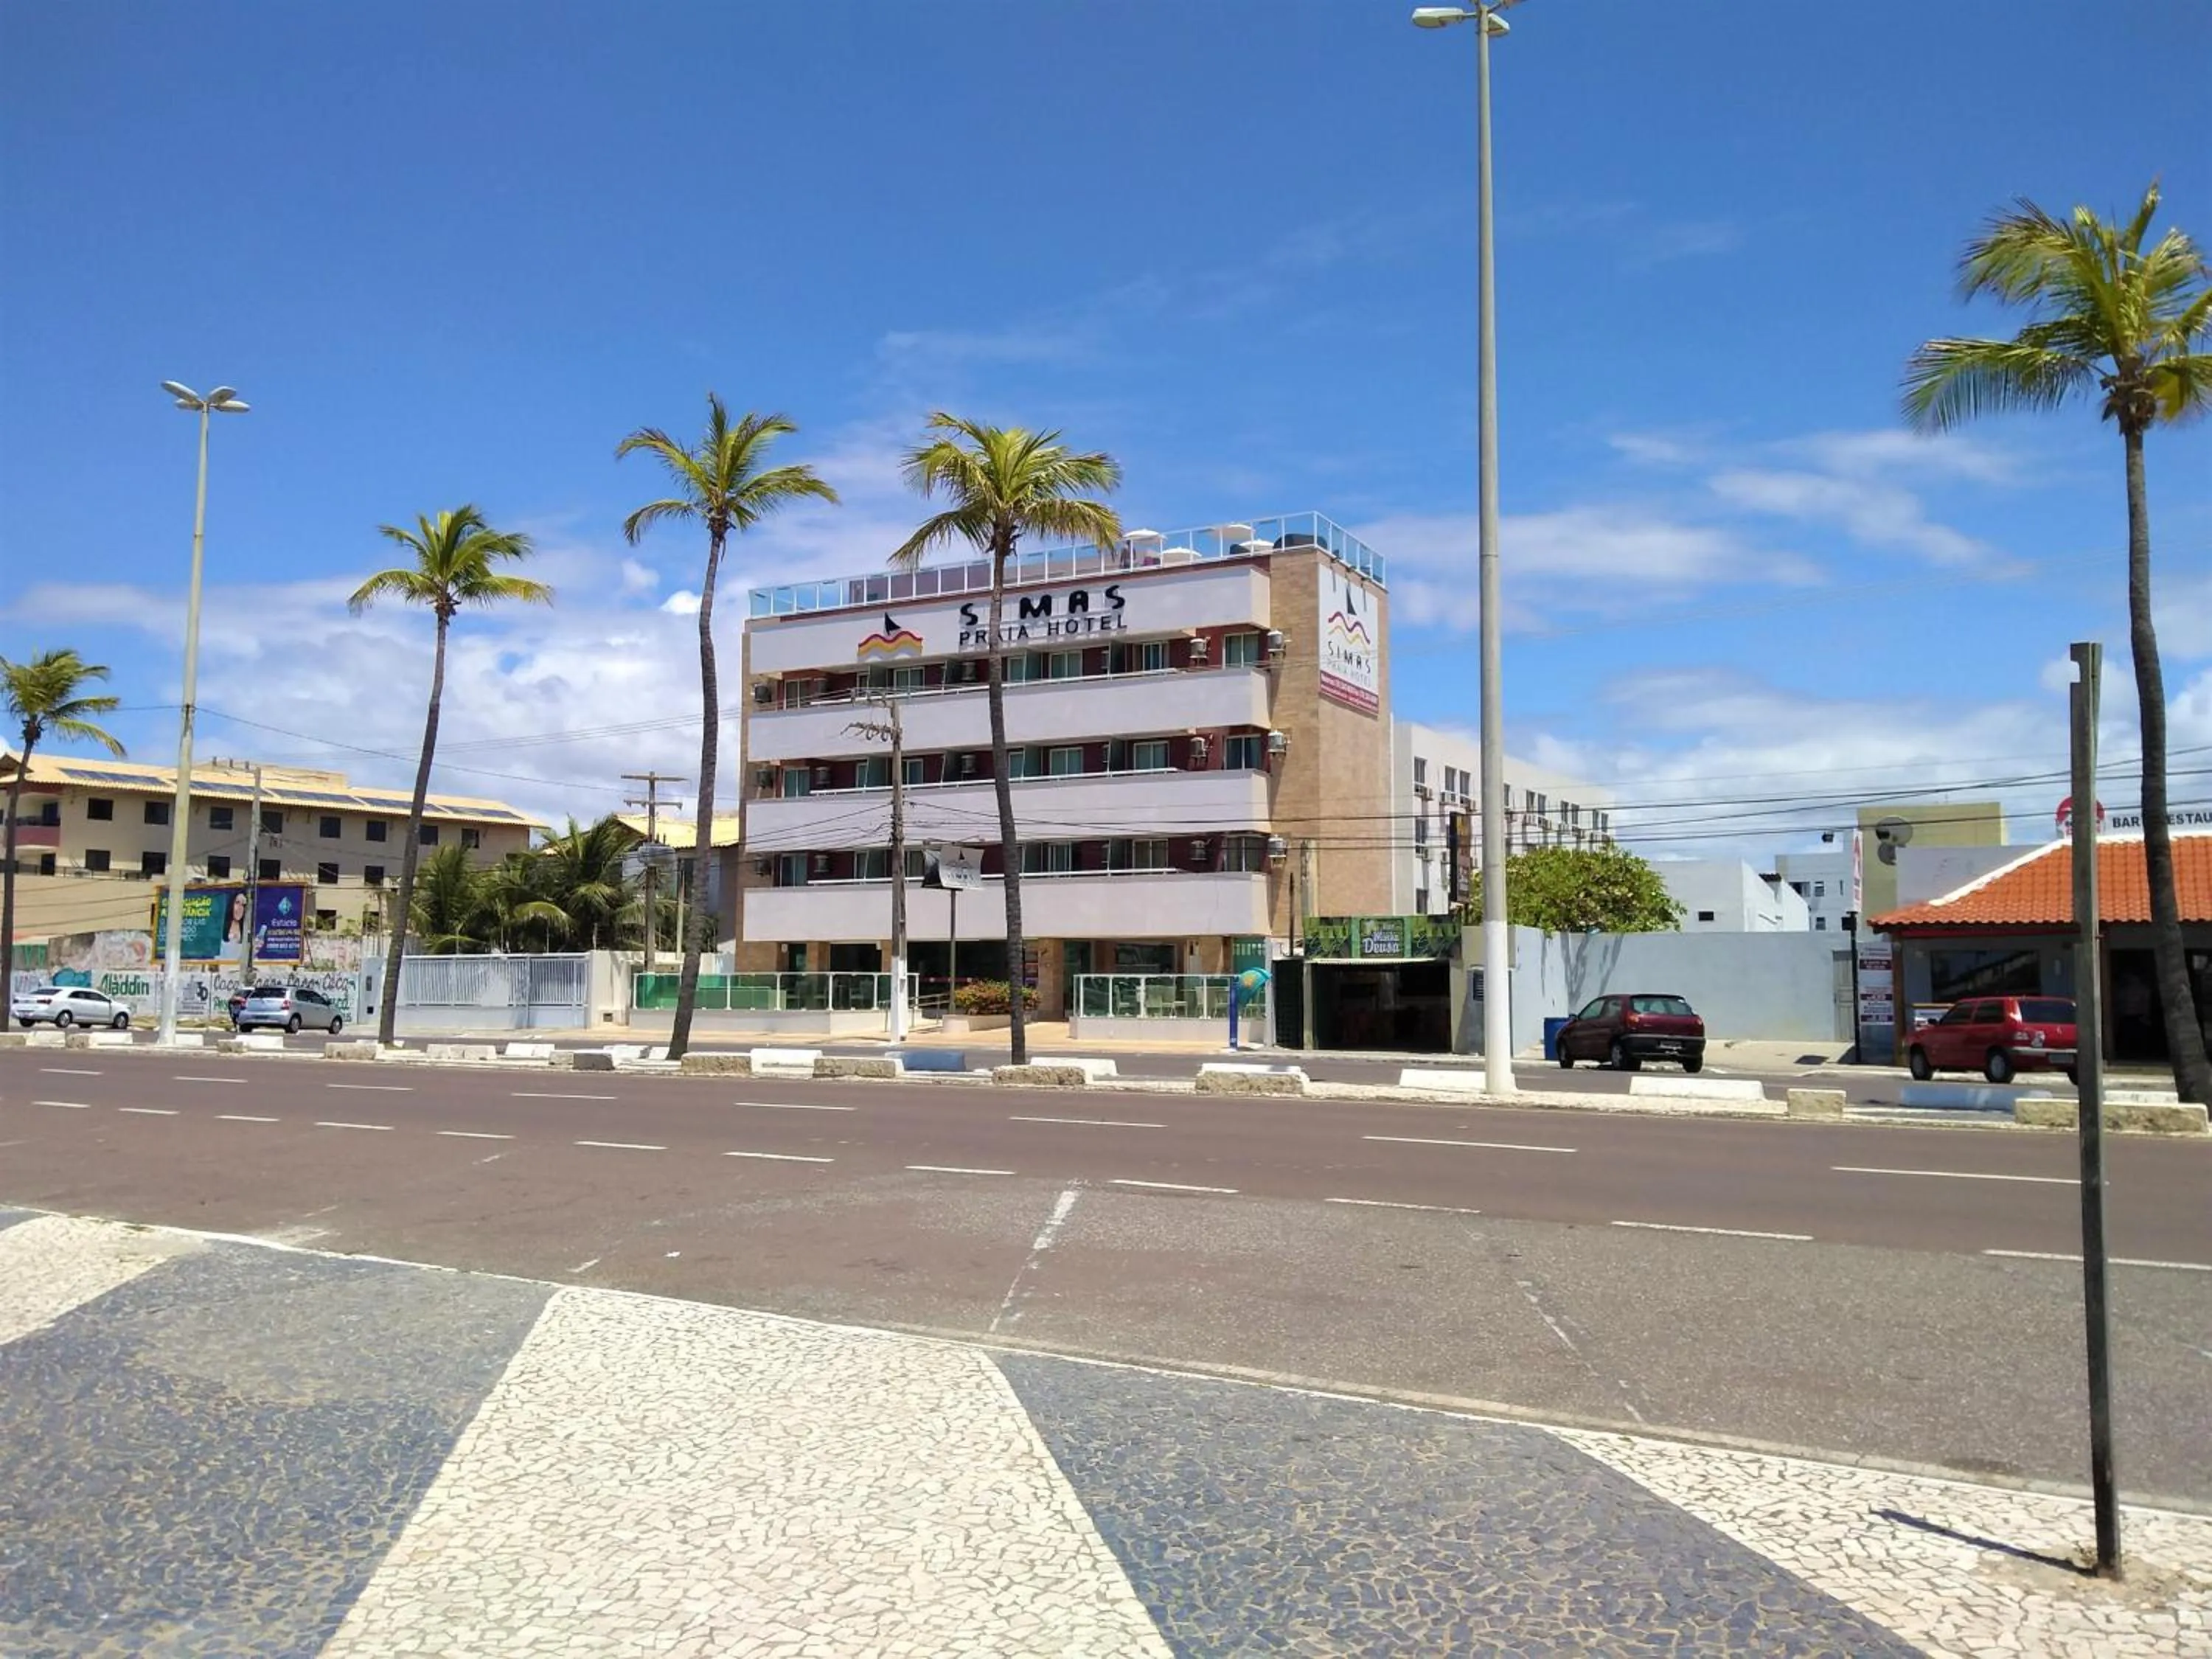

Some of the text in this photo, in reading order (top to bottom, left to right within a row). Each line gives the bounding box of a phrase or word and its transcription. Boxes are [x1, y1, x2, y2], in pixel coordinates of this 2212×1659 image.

[960, 585, 1127, 625] SMAS
[1048, 614, 1127, 636] HOTEL
[1328, 641, 1371, 674] SIMAS
[2112, 813, 2212, 828] BAR ESTAU
